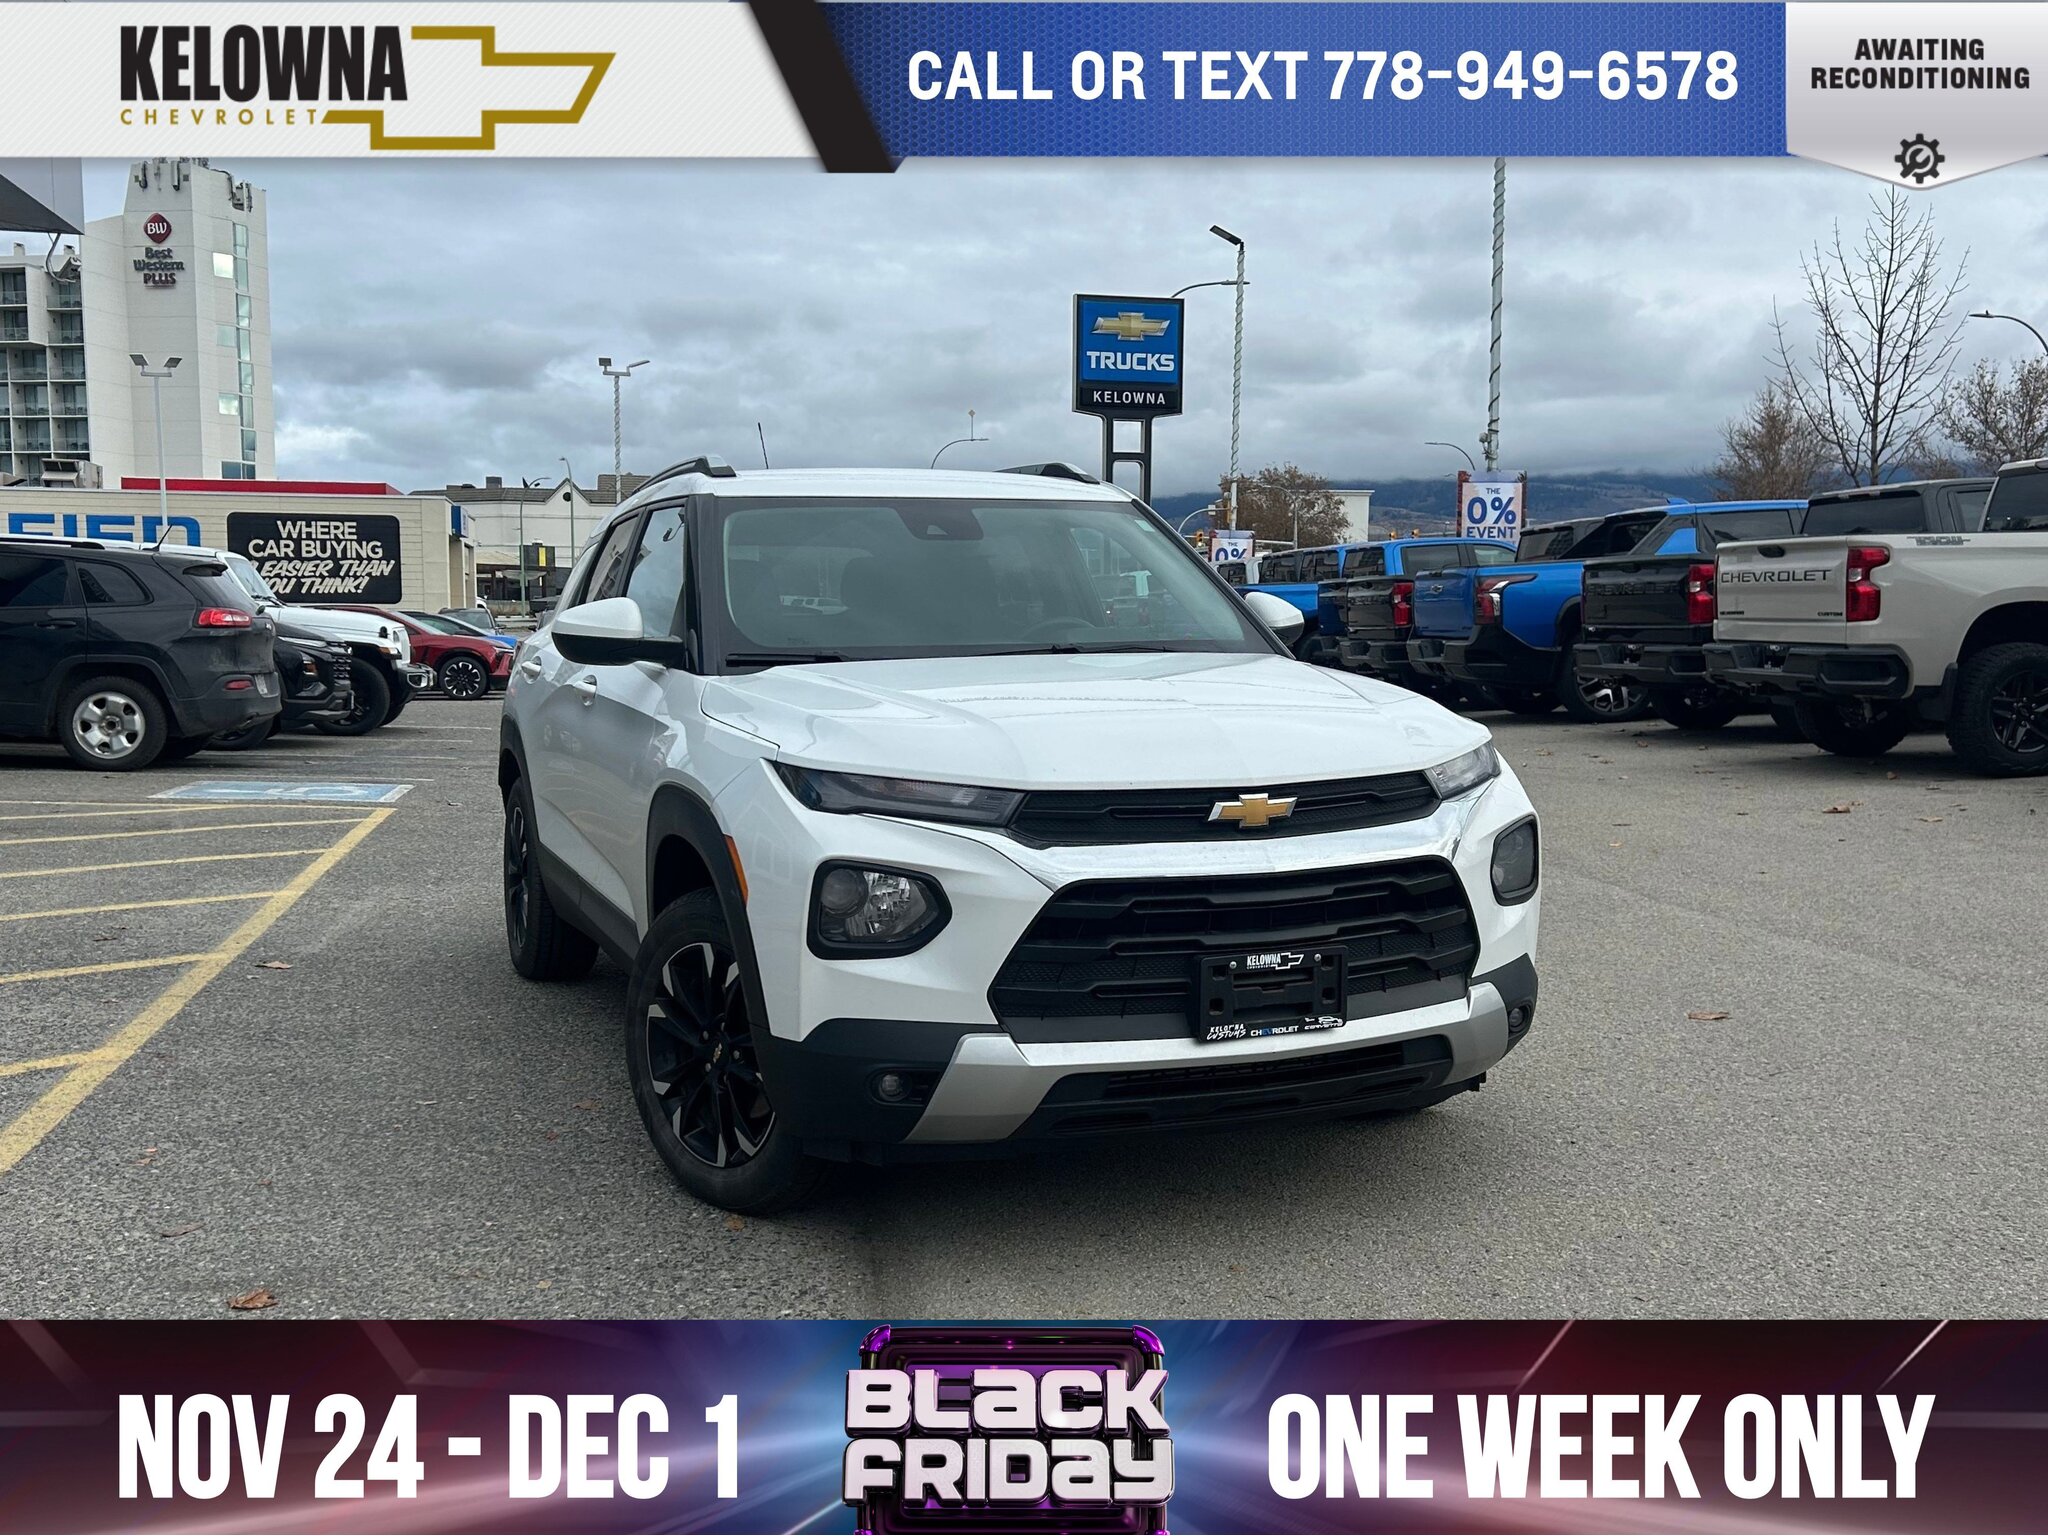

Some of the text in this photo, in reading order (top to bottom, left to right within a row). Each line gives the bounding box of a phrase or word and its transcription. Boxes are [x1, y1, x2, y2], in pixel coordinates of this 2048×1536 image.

[147, 222, 167, 235] BW
[144, 247, 174, 260] Best
[132, 259, 185, 272] Western
[143, 272, 177, 286] PLUS
[1086, 350, 1176, 372] TRUCKS
[1093, 390, 1166, 405] KELOWNA
[1485, 487, 1502, 495] THE
[1467, 496, 1517, 525] 0%
[276, 520, 358, 540] WHERE
[1466, 526, 1517, 539] EVENT
[248, 539, 384, 559] CAR BUYING
[260, 559, 334, 577] EASIER
[338, 559, 396, 577] THAN
[1720, 568, 1833, 584] CHEVROLET
[299, 575, 371, 594] THINK!
[1246, 952, 1282, 967] KELOWNA
[1250, 1025, 1300, 1037] CHEVROLET
